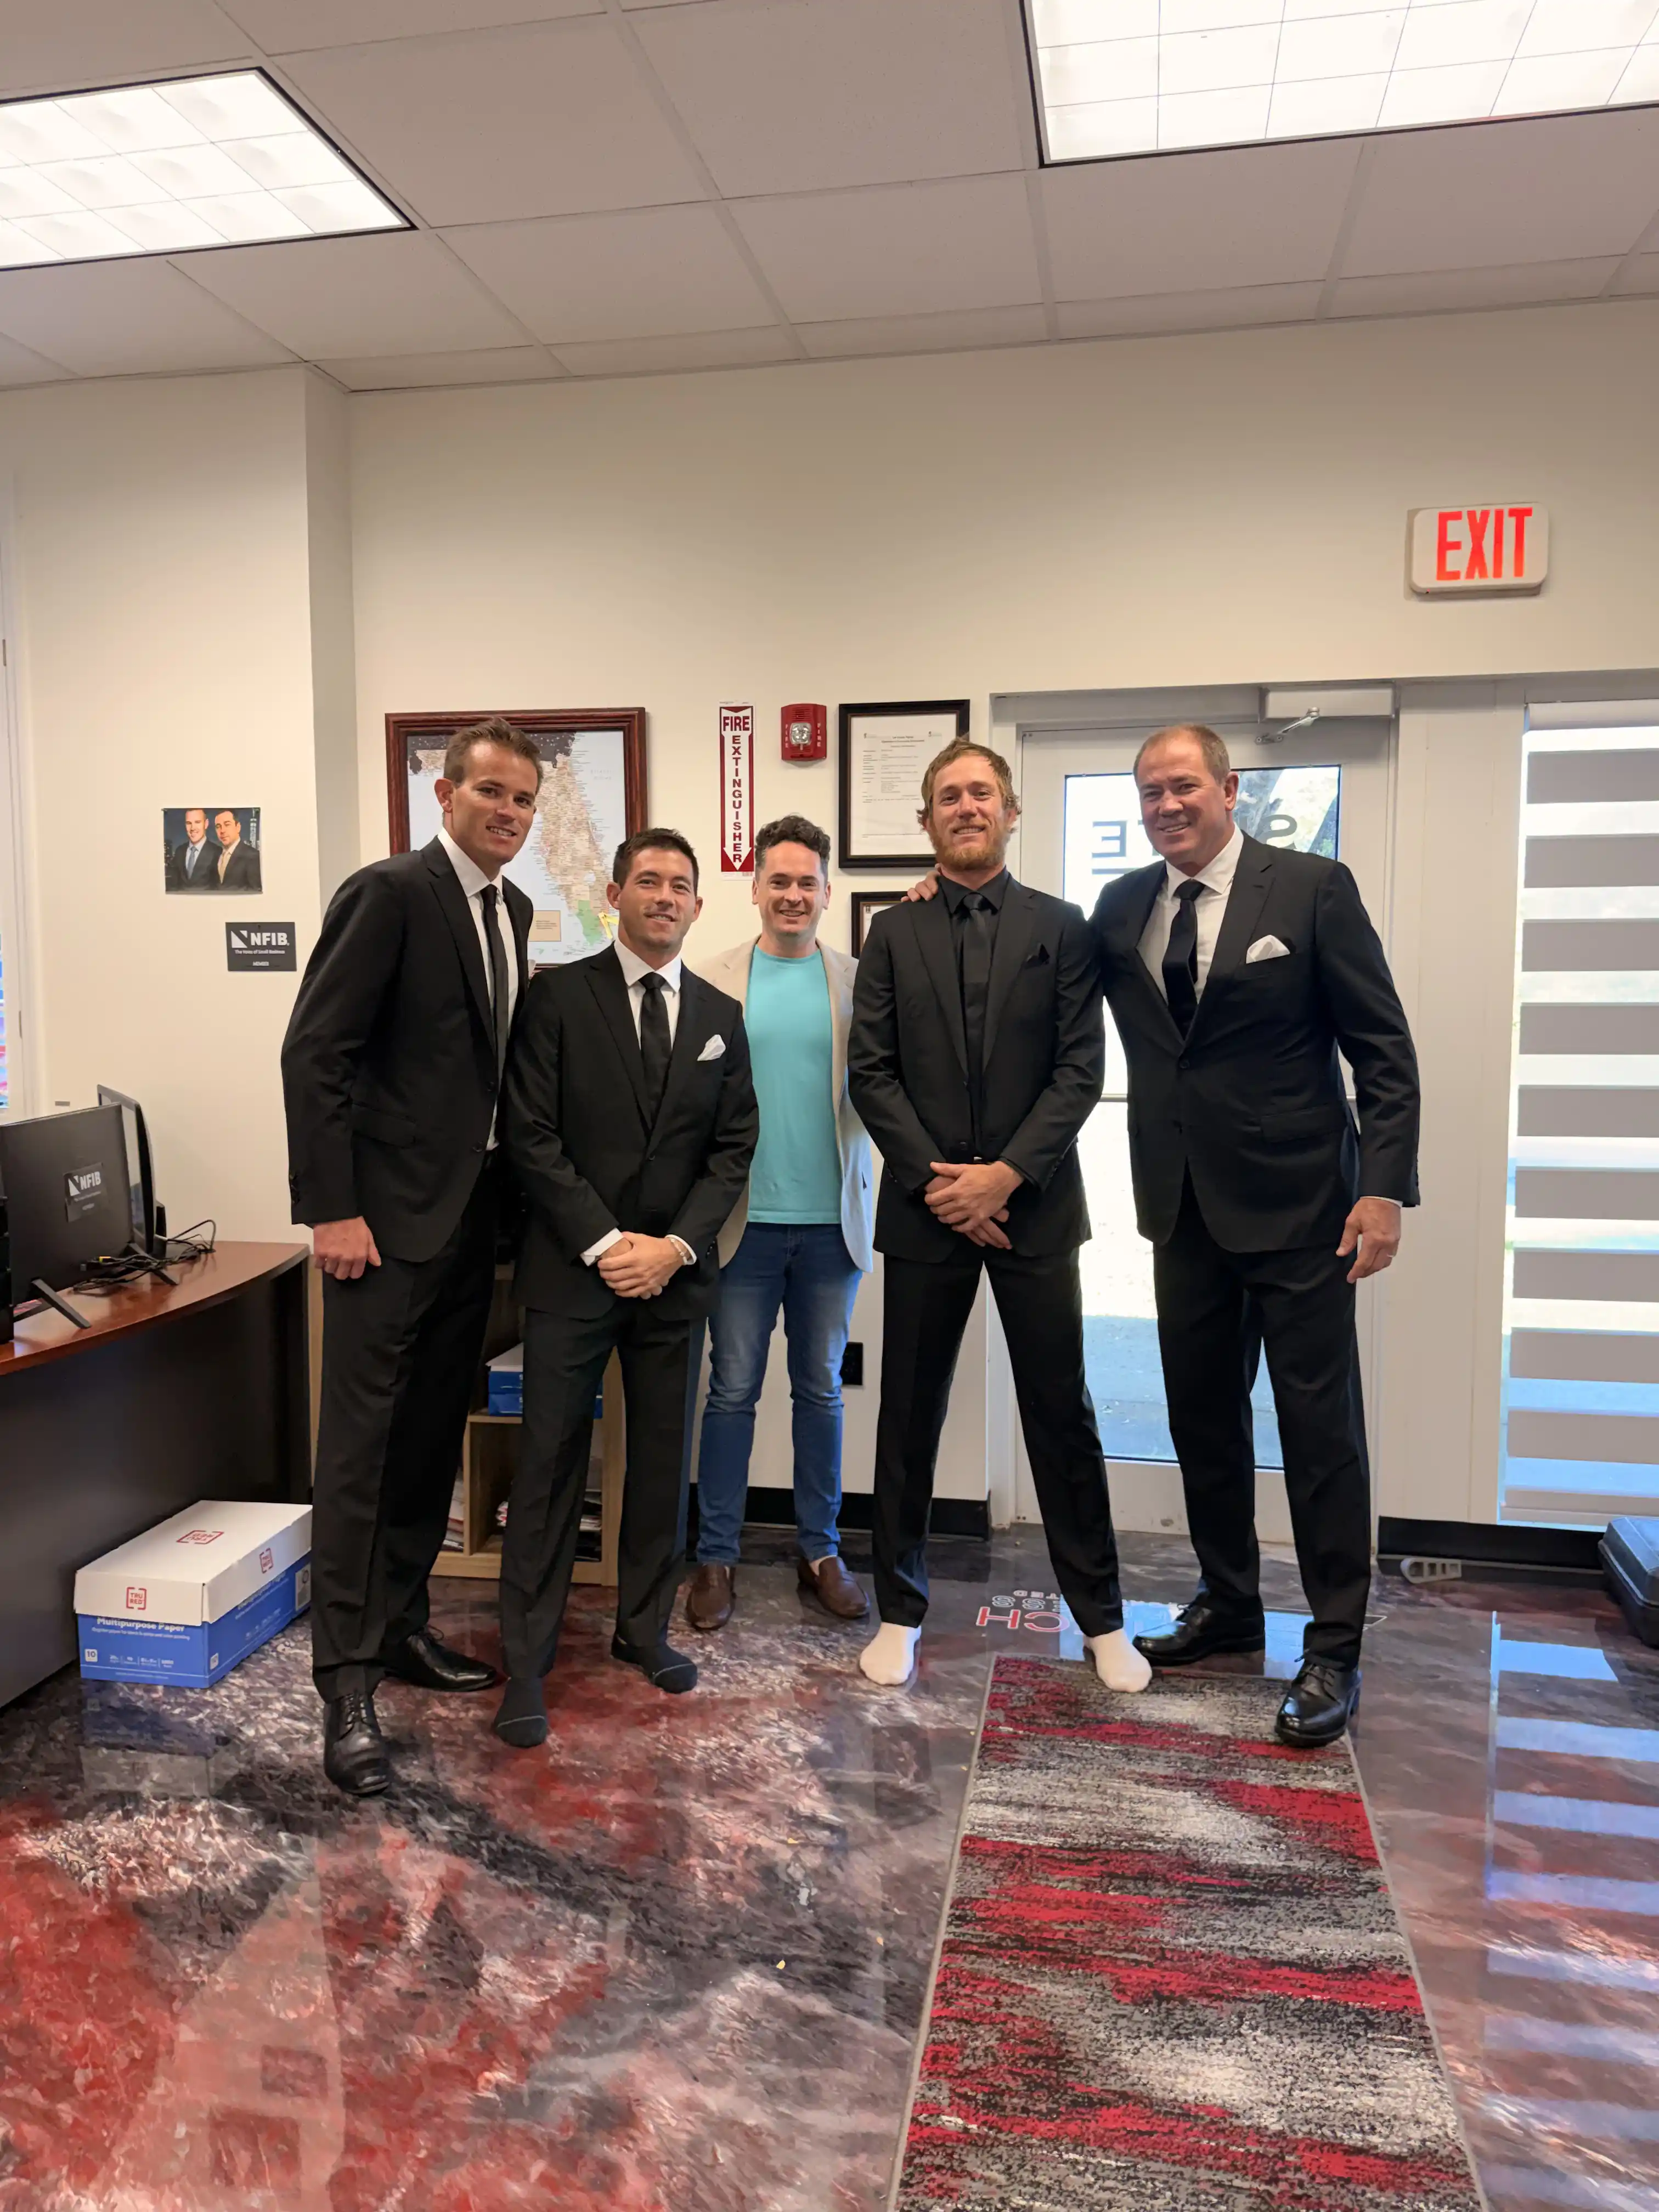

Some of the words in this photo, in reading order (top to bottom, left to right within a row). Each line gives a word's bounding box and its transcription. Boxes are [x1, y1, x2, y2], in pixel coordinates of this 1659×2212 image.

[1436, 507, 1533, 580] EXIT
[723, 715, 750, 731] FIRE
[732, 735, 742, 863] EXTINGUISHER
[250, 932, 288, 946] NFIB
[80, 1171, 101, 1190] NFIB
[97, 1617, 157, 1630] Multipurpose
[158, 1623, 185, 1633] Paper
